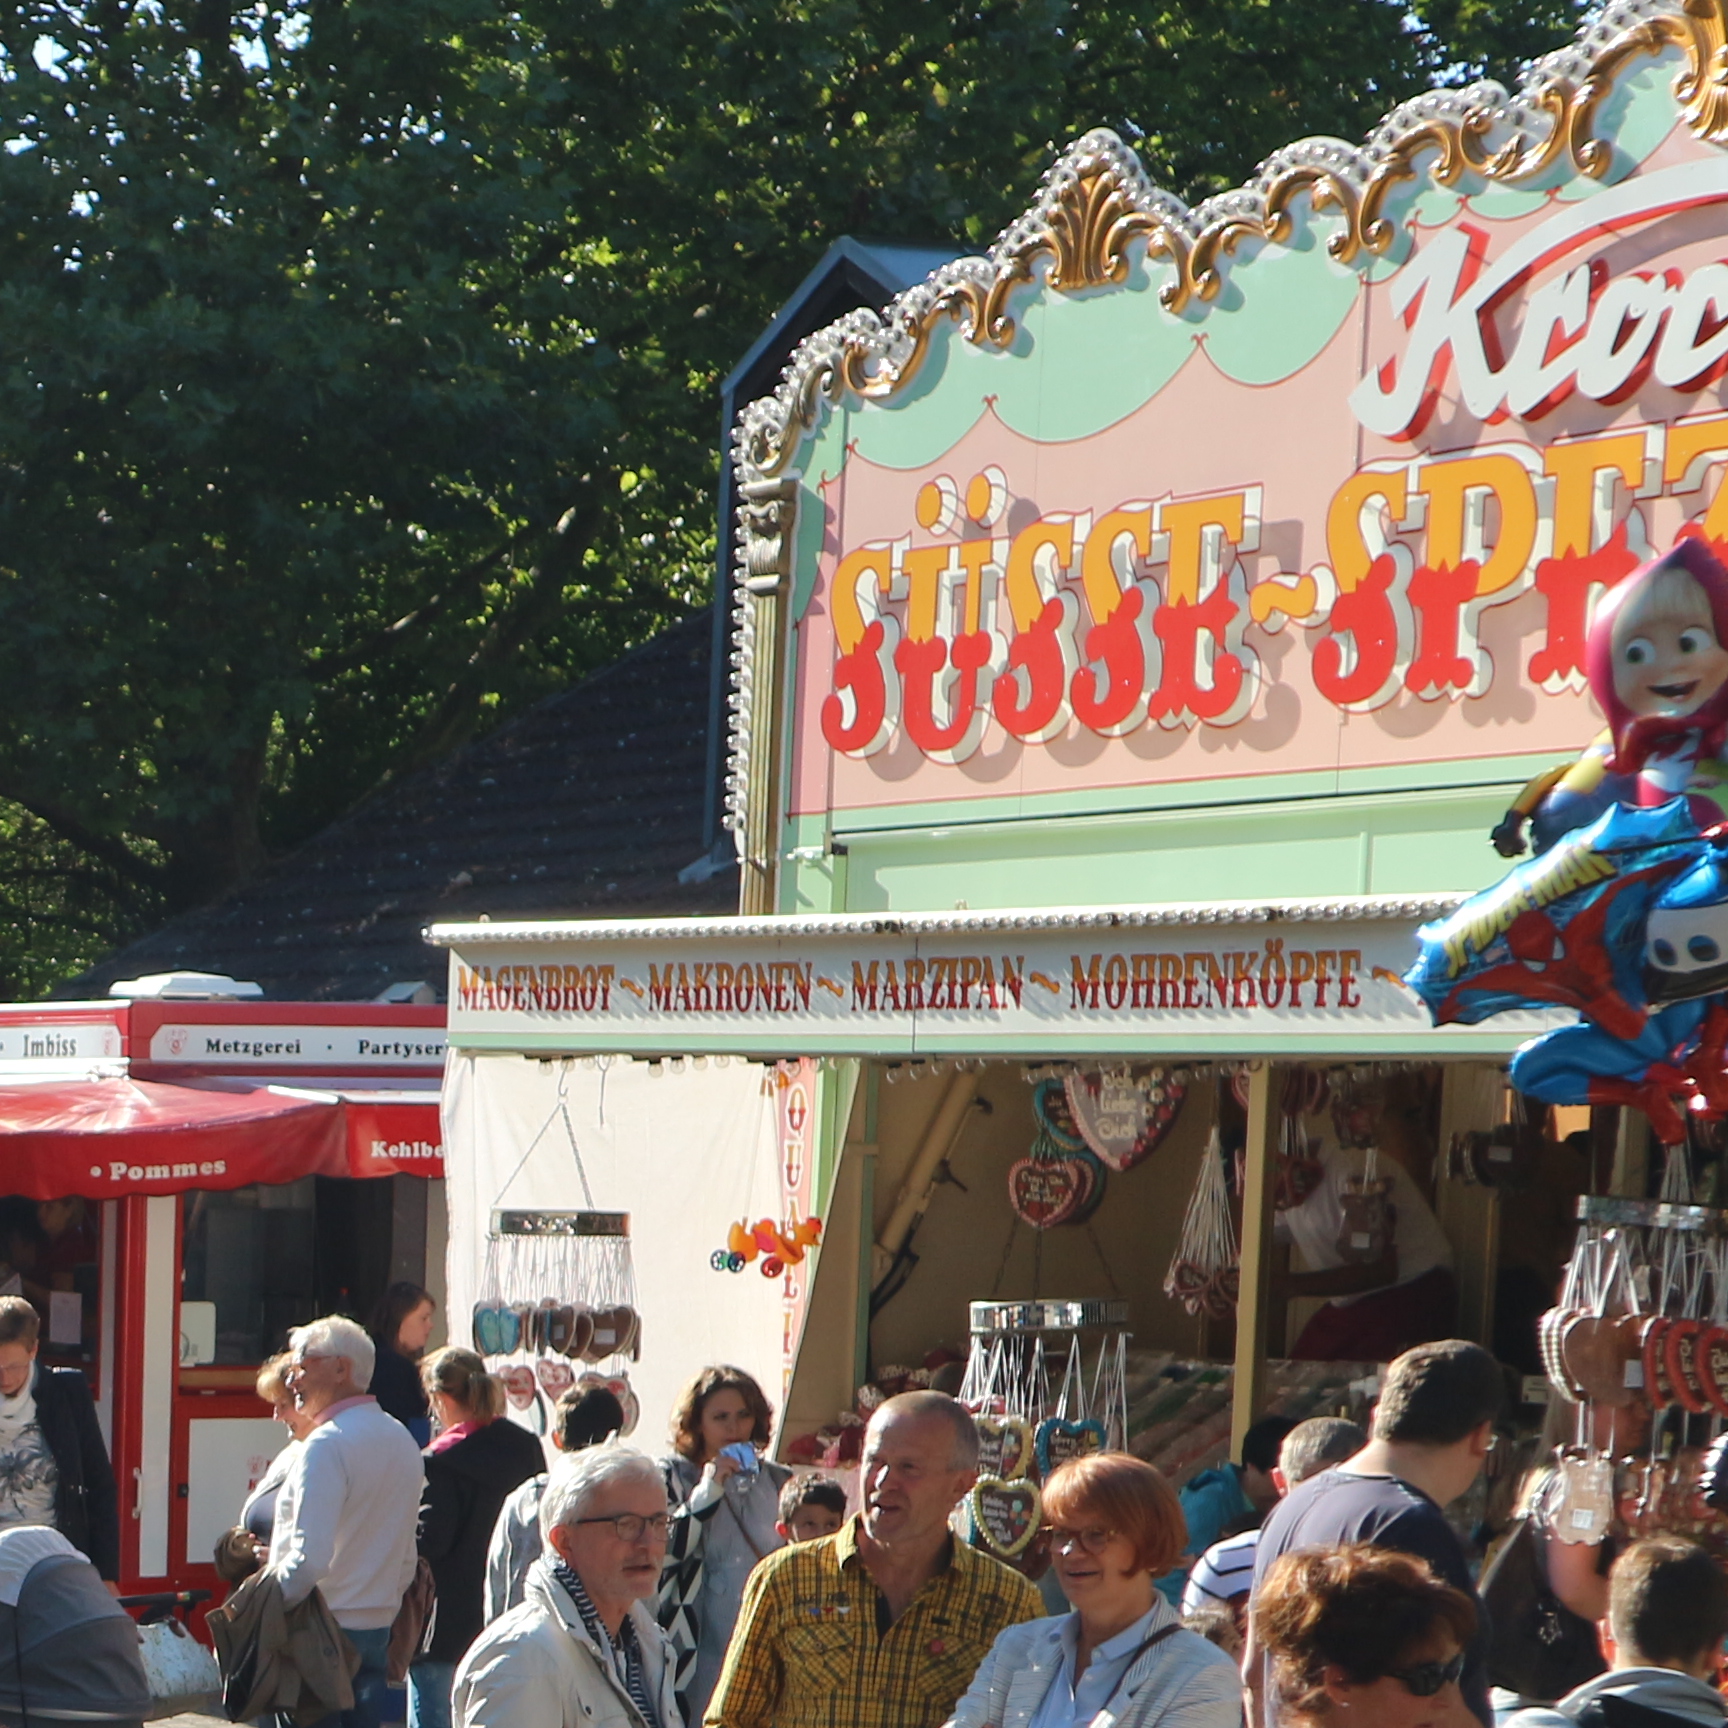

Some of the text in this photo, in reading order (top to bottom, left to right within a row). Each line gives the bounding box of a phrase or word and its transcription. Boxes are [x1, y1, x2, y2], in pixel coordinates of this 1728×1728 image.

[821, 466, 1250, 757] SÜSSE
[456, 938, 1362, 1013] MAGENBROT MAKRONEN MARZIPAN MOHRENKÖPFE
[23, 1034, 77, 1057] Imbiss
[205, 1038, 449, 1057] Metzgerei Partyser
[109, 1160, 226, 1180] Pommes
